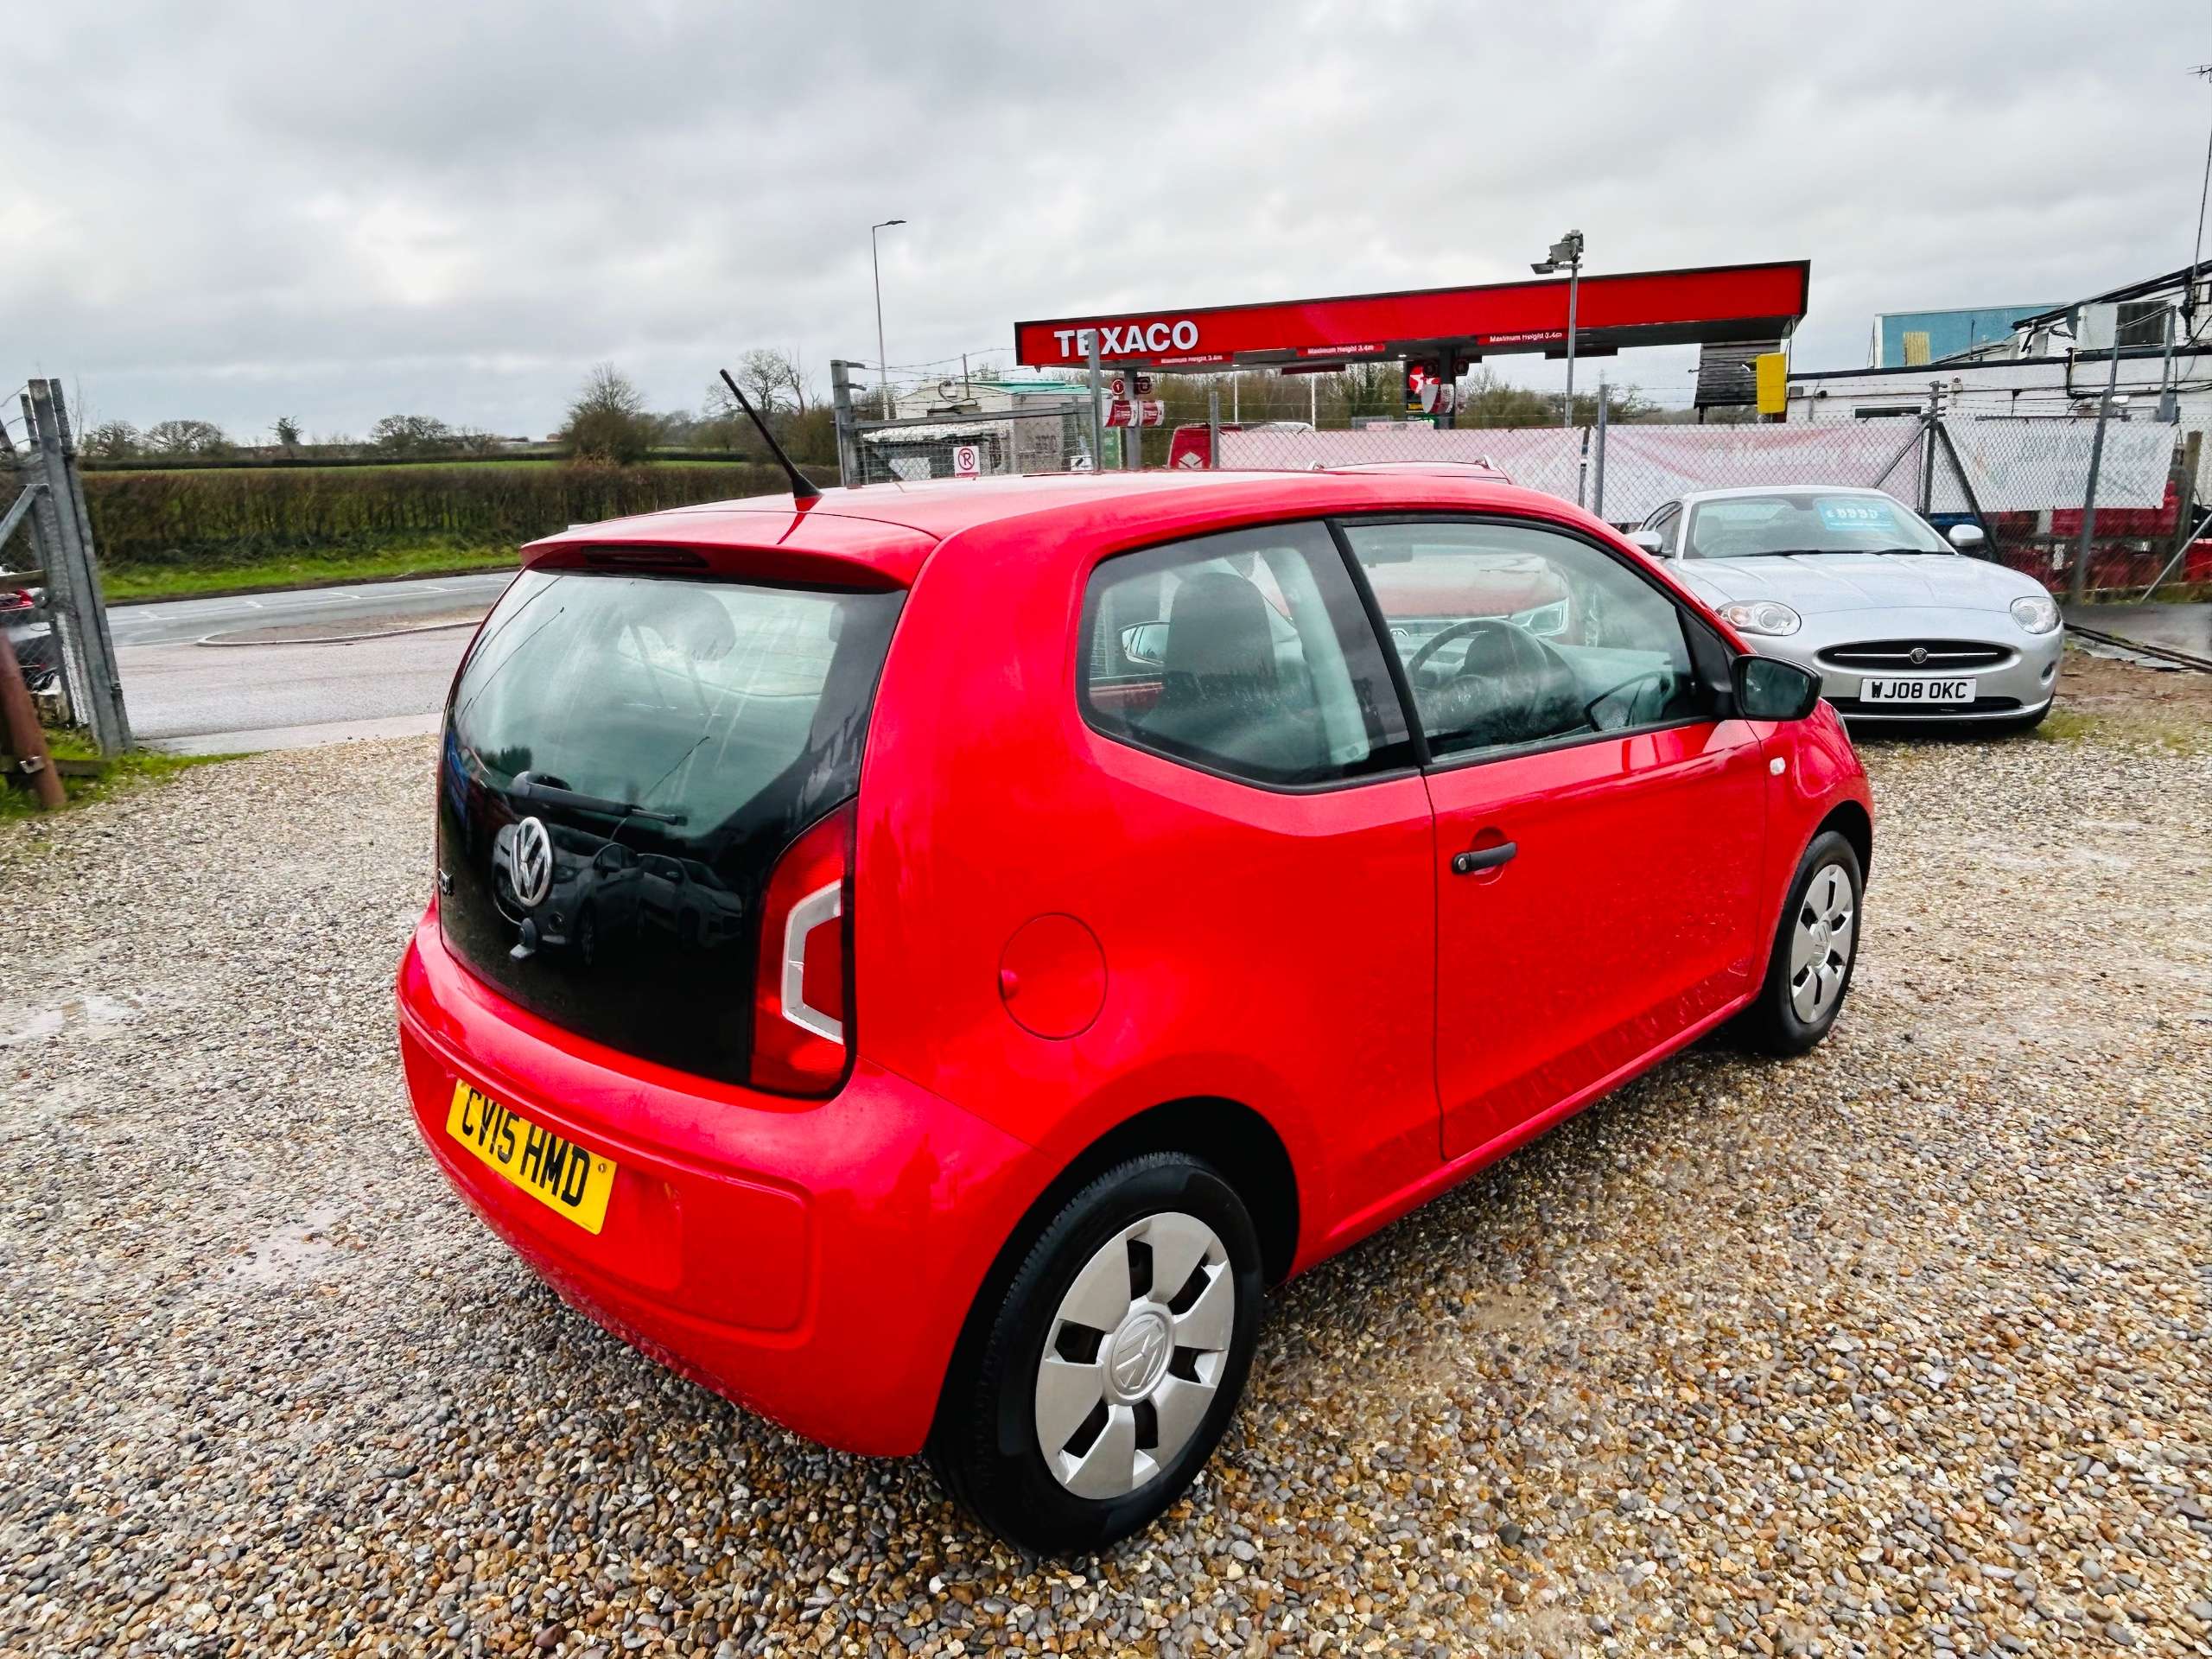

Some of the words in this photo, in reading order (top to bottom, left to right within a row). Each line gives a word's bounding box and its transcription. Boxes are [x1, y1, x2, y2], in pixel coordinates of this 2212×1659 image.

[1054, 321, 1198, 357] TEXACO
[1871, 681, 1923, 699] WJ08
[1929, 682, 1967, 699] OKC
[461, 1087, 520, 1165] CV15
[519, 1123, 591, 1208] HMD
